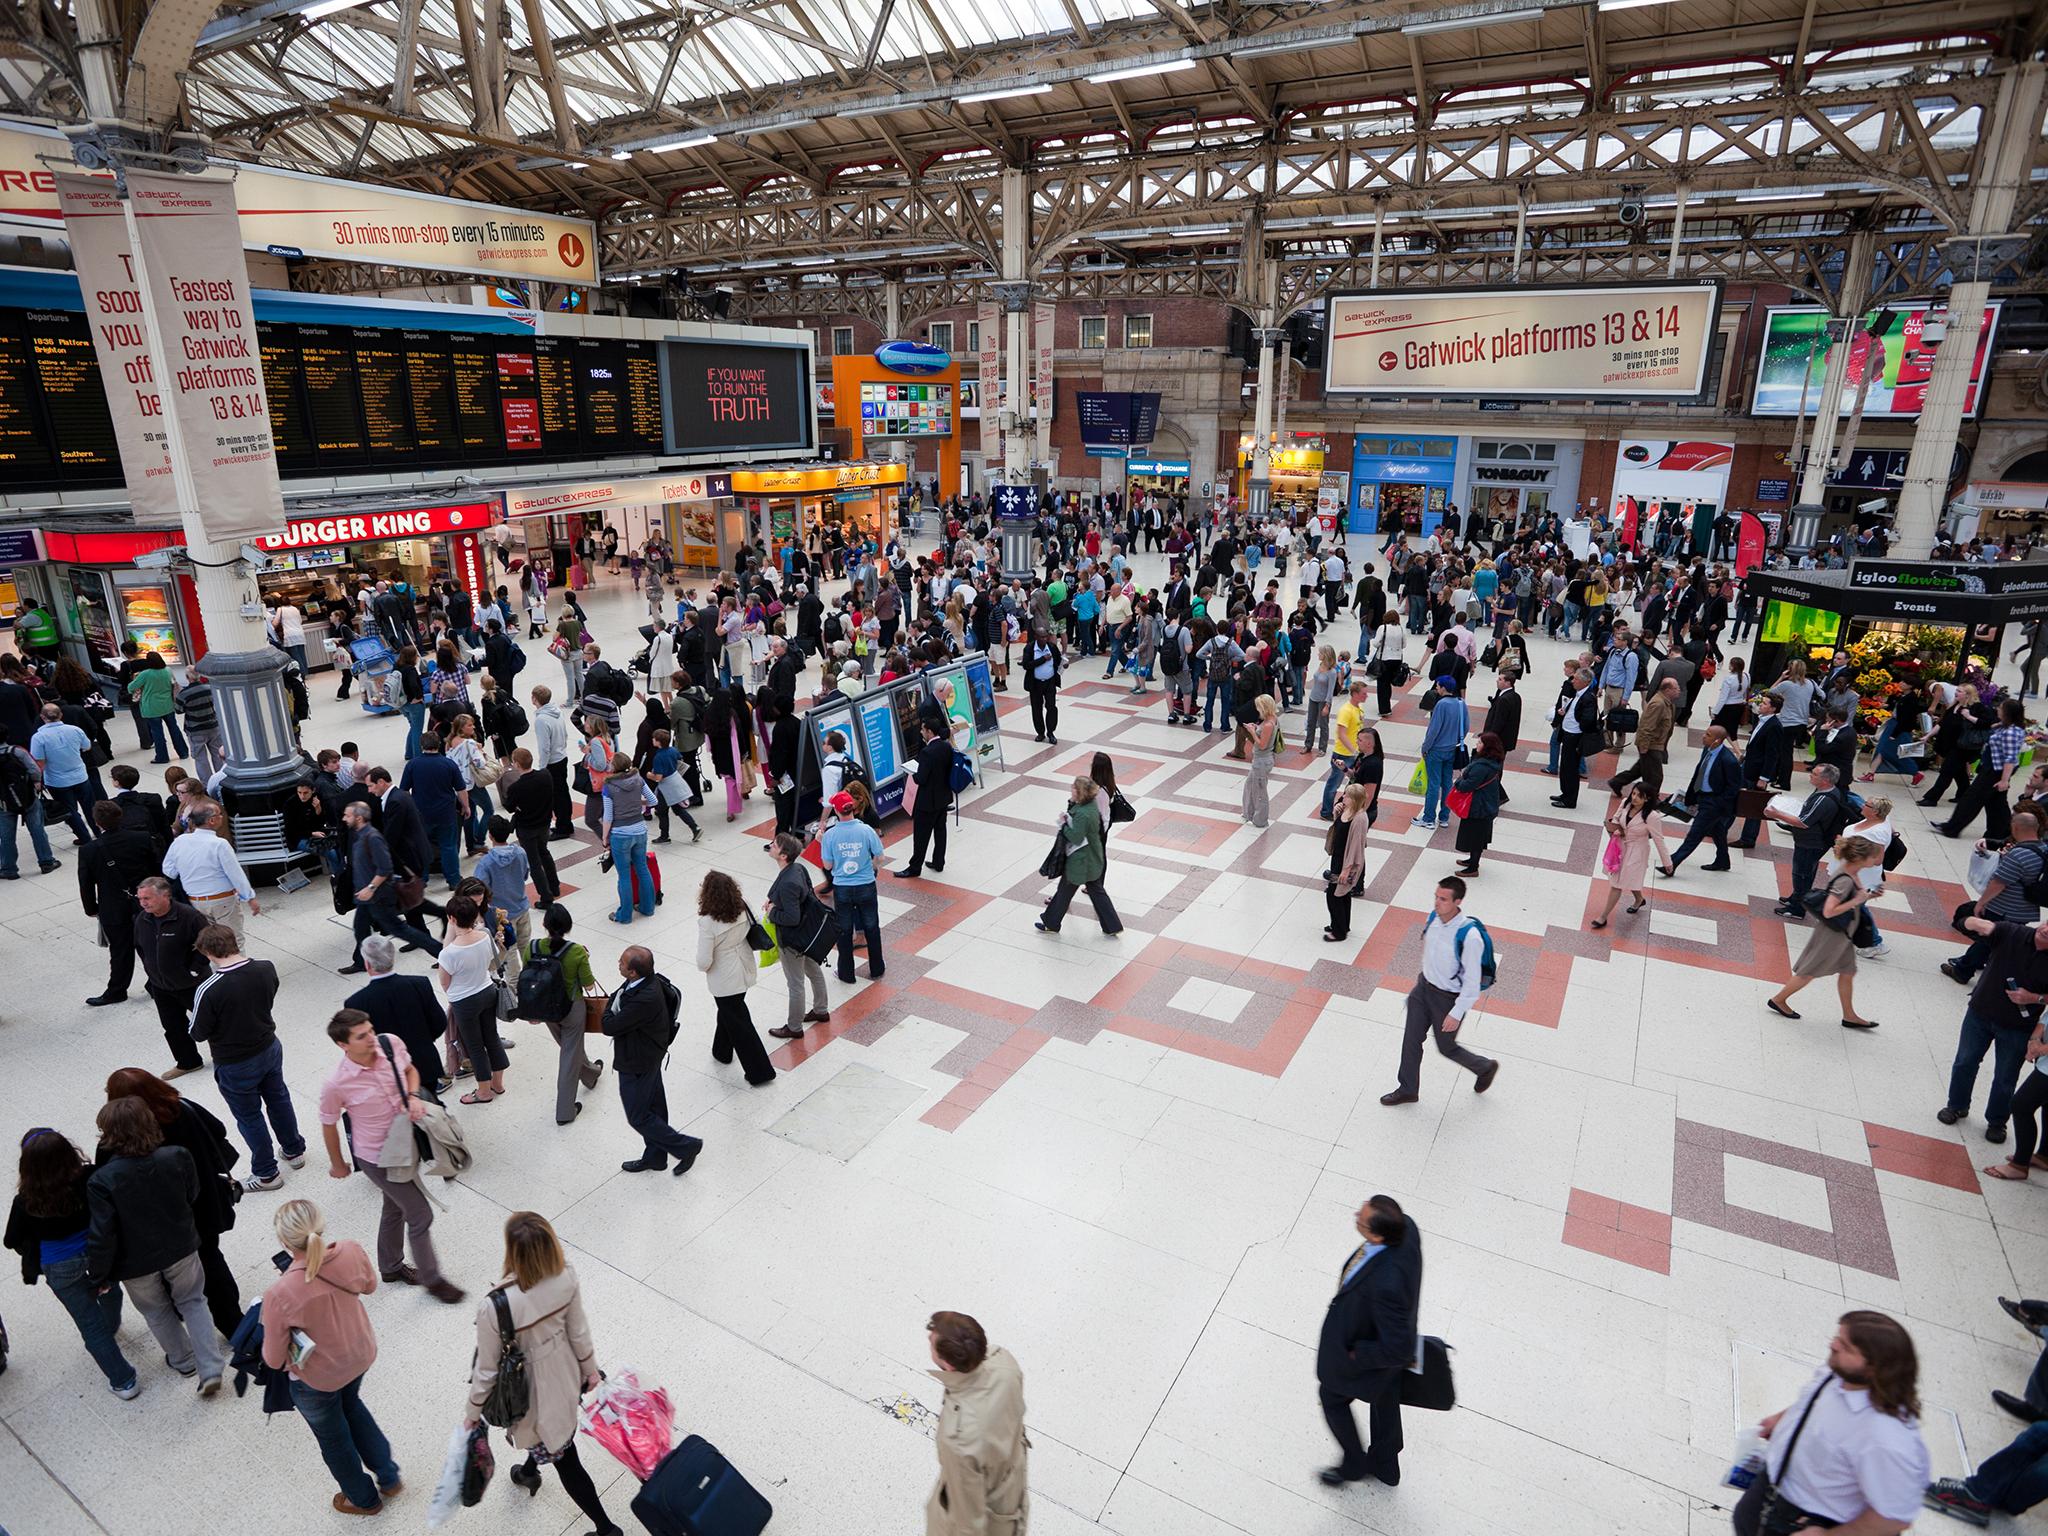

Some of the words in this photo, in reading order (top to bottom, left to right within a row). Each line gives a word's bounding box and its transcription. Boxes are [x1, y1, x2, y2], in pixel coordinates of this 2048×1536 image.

[332, 221, 352, 245] 30
[355, 222, 391, 245] mins
[391, 222, 450, 246] non-stop
[452, 223, 485, 245] every
[485, 220, 499, 242] 15
[500, 220, 545, 242] minutes
[271, 247, 301, 257] JCDecaux
[477, 248, 549, 262] gatwickexpress.com
[170, 276, 235, 303] Fastest
[27, 312, 70, 323] Departures
[183, 308, 221, 339] way
[222, 306, 242, 330] to
[1905, 319, 1922, 327] ALL
[101, 322, 143, 351] you
[299, 327, 329, 336] Departures
[353, 330, 381, 339] Departures
[404, 332, 430, 340] Departures
[450, 334, 475, 342] Departures
[1404, 334, 1486, 371] Gatwick
[1491, 320, 1597, 364] platforms
[1602, 312, 1625, 346] 13
[1631, 309, 1650, 342] &
[1655, 304, 1680, 339] 14
[58, 338, 90, 348] Platform
[182, 334, 251, 361] Gatwick
[34, 346, 67, 355] Brighton
[1612, 351, 1622, 362] 30
[1623, 349, 1643, 360] mins
[1644, 346, 1680, 357] non-stop
[124, 355, 154, 384] off
[1626, 359, 1648, 370] every
[1649, 357, 1658, 367] 15
[1659, 356, 1679, 366] mins
[177, 365, 257, 395] platforms
[707, 367, 716, 381] IF
[717, 367, 738, 381] YOU
[739, 369, 766, 382] WANT
[1603, 366, 1679, 383] gatwickexpress.com
[707, 382, 722, 396] TO
[724, 383, 747, 396] RUIN
[749, 383, 768, 396] THE
[209, 396, 229, 421] 13
[231, 394, 247, 419] &
[246, 392, 263, 418] 14
[707, 397, 770, 422] TRUTH
[143, 432, 155, 442] 30
[216, 436, 226, 446] 30
[226, 436, 243, 445] mins
[231, 444, 249, 455] every
[250, 442, 257, 452] 15
[318, 442, 338, 450] Gatwick
[338, 441, 360, 449] Express
[60, 451, 94, 459] Southern
[860, 467, 882, 481] Crust
[1477, 467, 1551, 483] TONI&GUY
[662, 483, 688, 501] Tickets
[714, 480, 725, 492] 14
[265, 516, 367, 548] BURGER
[371, 511, 431, 537] KING
[464, 549, 478, 590] BURGER
[1771, 584, 1811, 600] weddings
[2002, 581, 2048, 594] iglooflowers.
[1894, 601, 1937, 613] Events
[2009, 606, 2029, 616] fresh
[883, 787, 904, 802] Victoria
[838, 842, 863, 851] Kings
